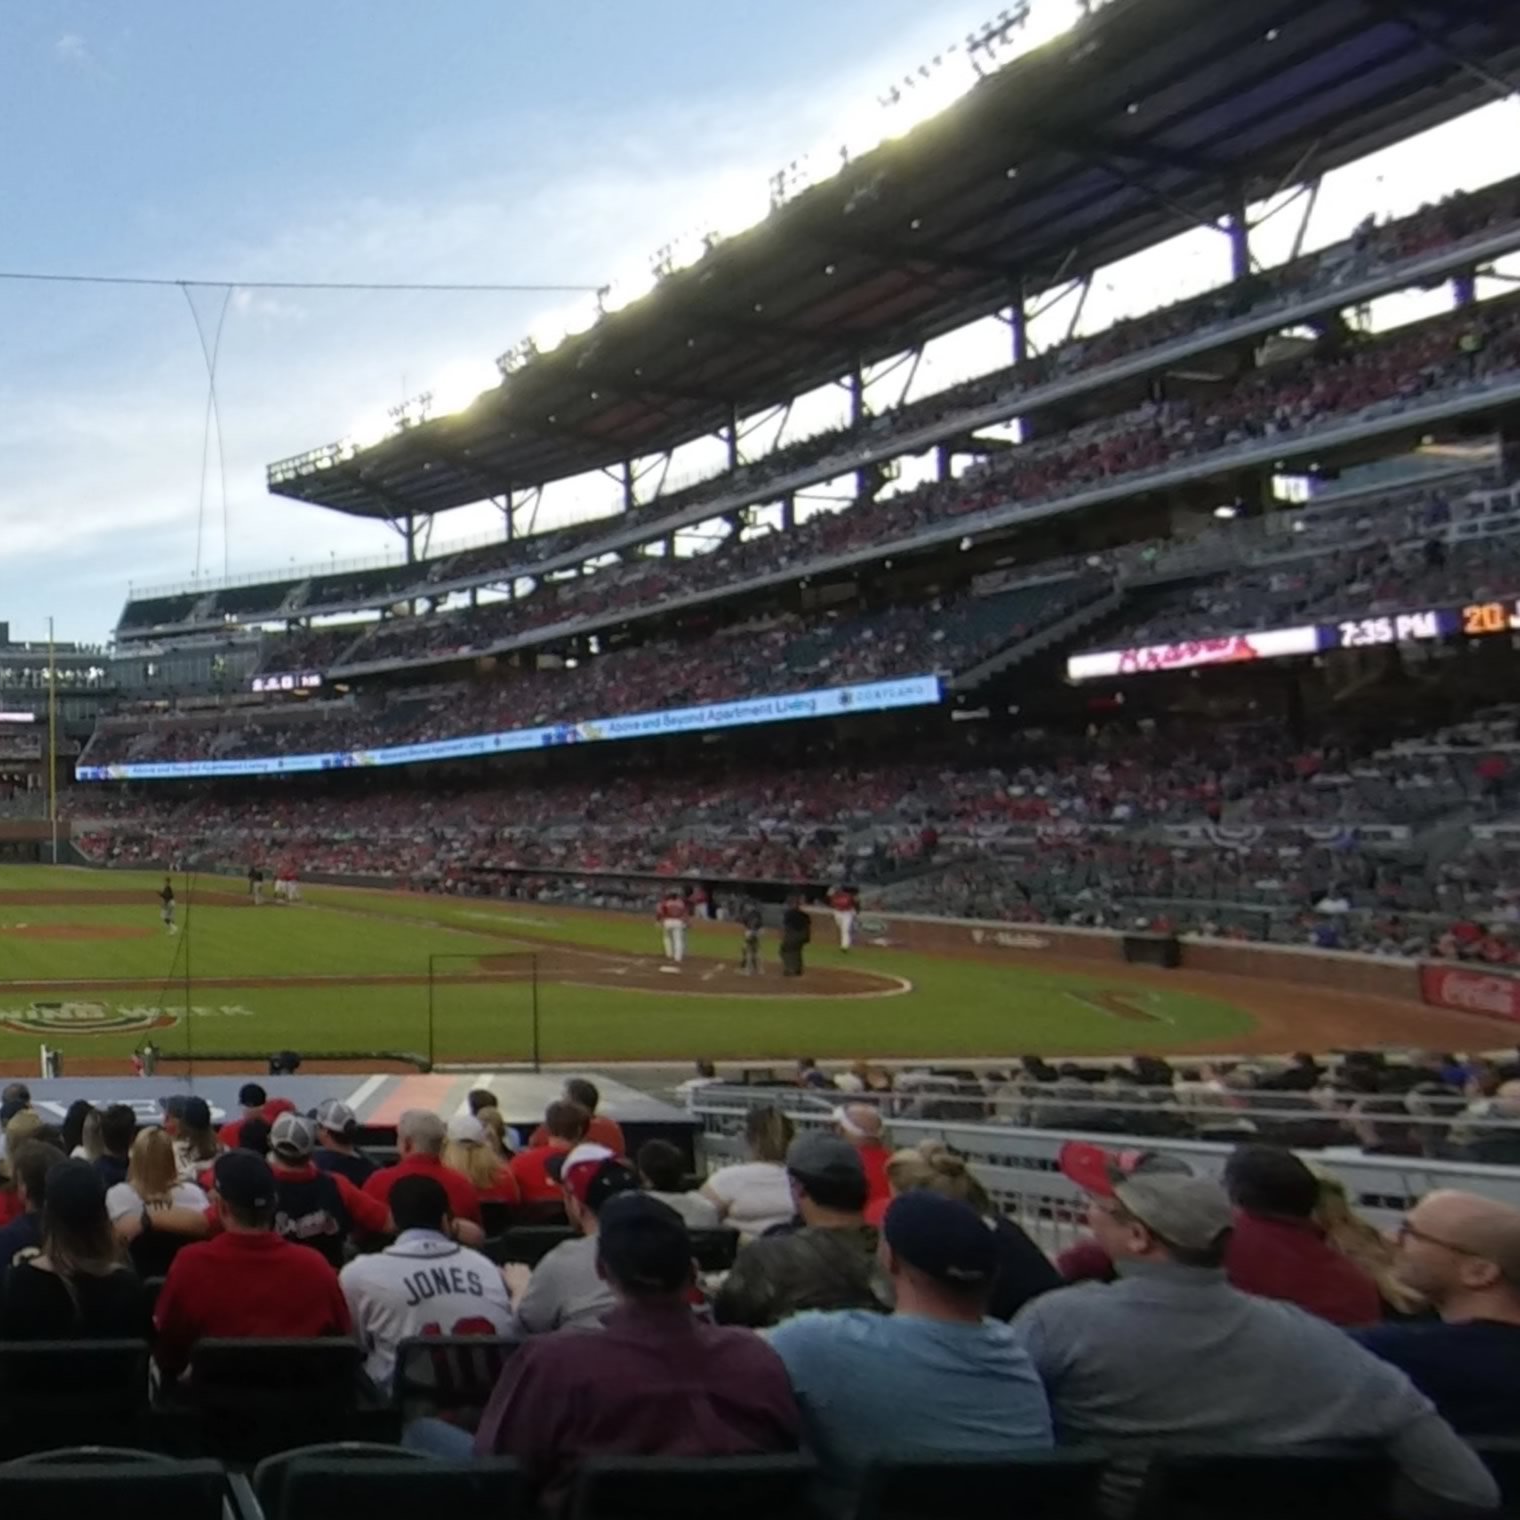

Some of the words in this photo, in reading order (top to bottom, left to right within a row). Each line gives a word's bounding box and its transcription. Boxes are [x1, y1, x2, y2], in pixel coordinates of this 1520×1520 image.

[1337, 617, 1394, 647] 7:35
[1395, 611, 1437, 640] PM
[1462, 602, 1505, 633] 20
[119, 1004, 254, 1018] WEEK
[403, 1266, 484, 1307] JONES
